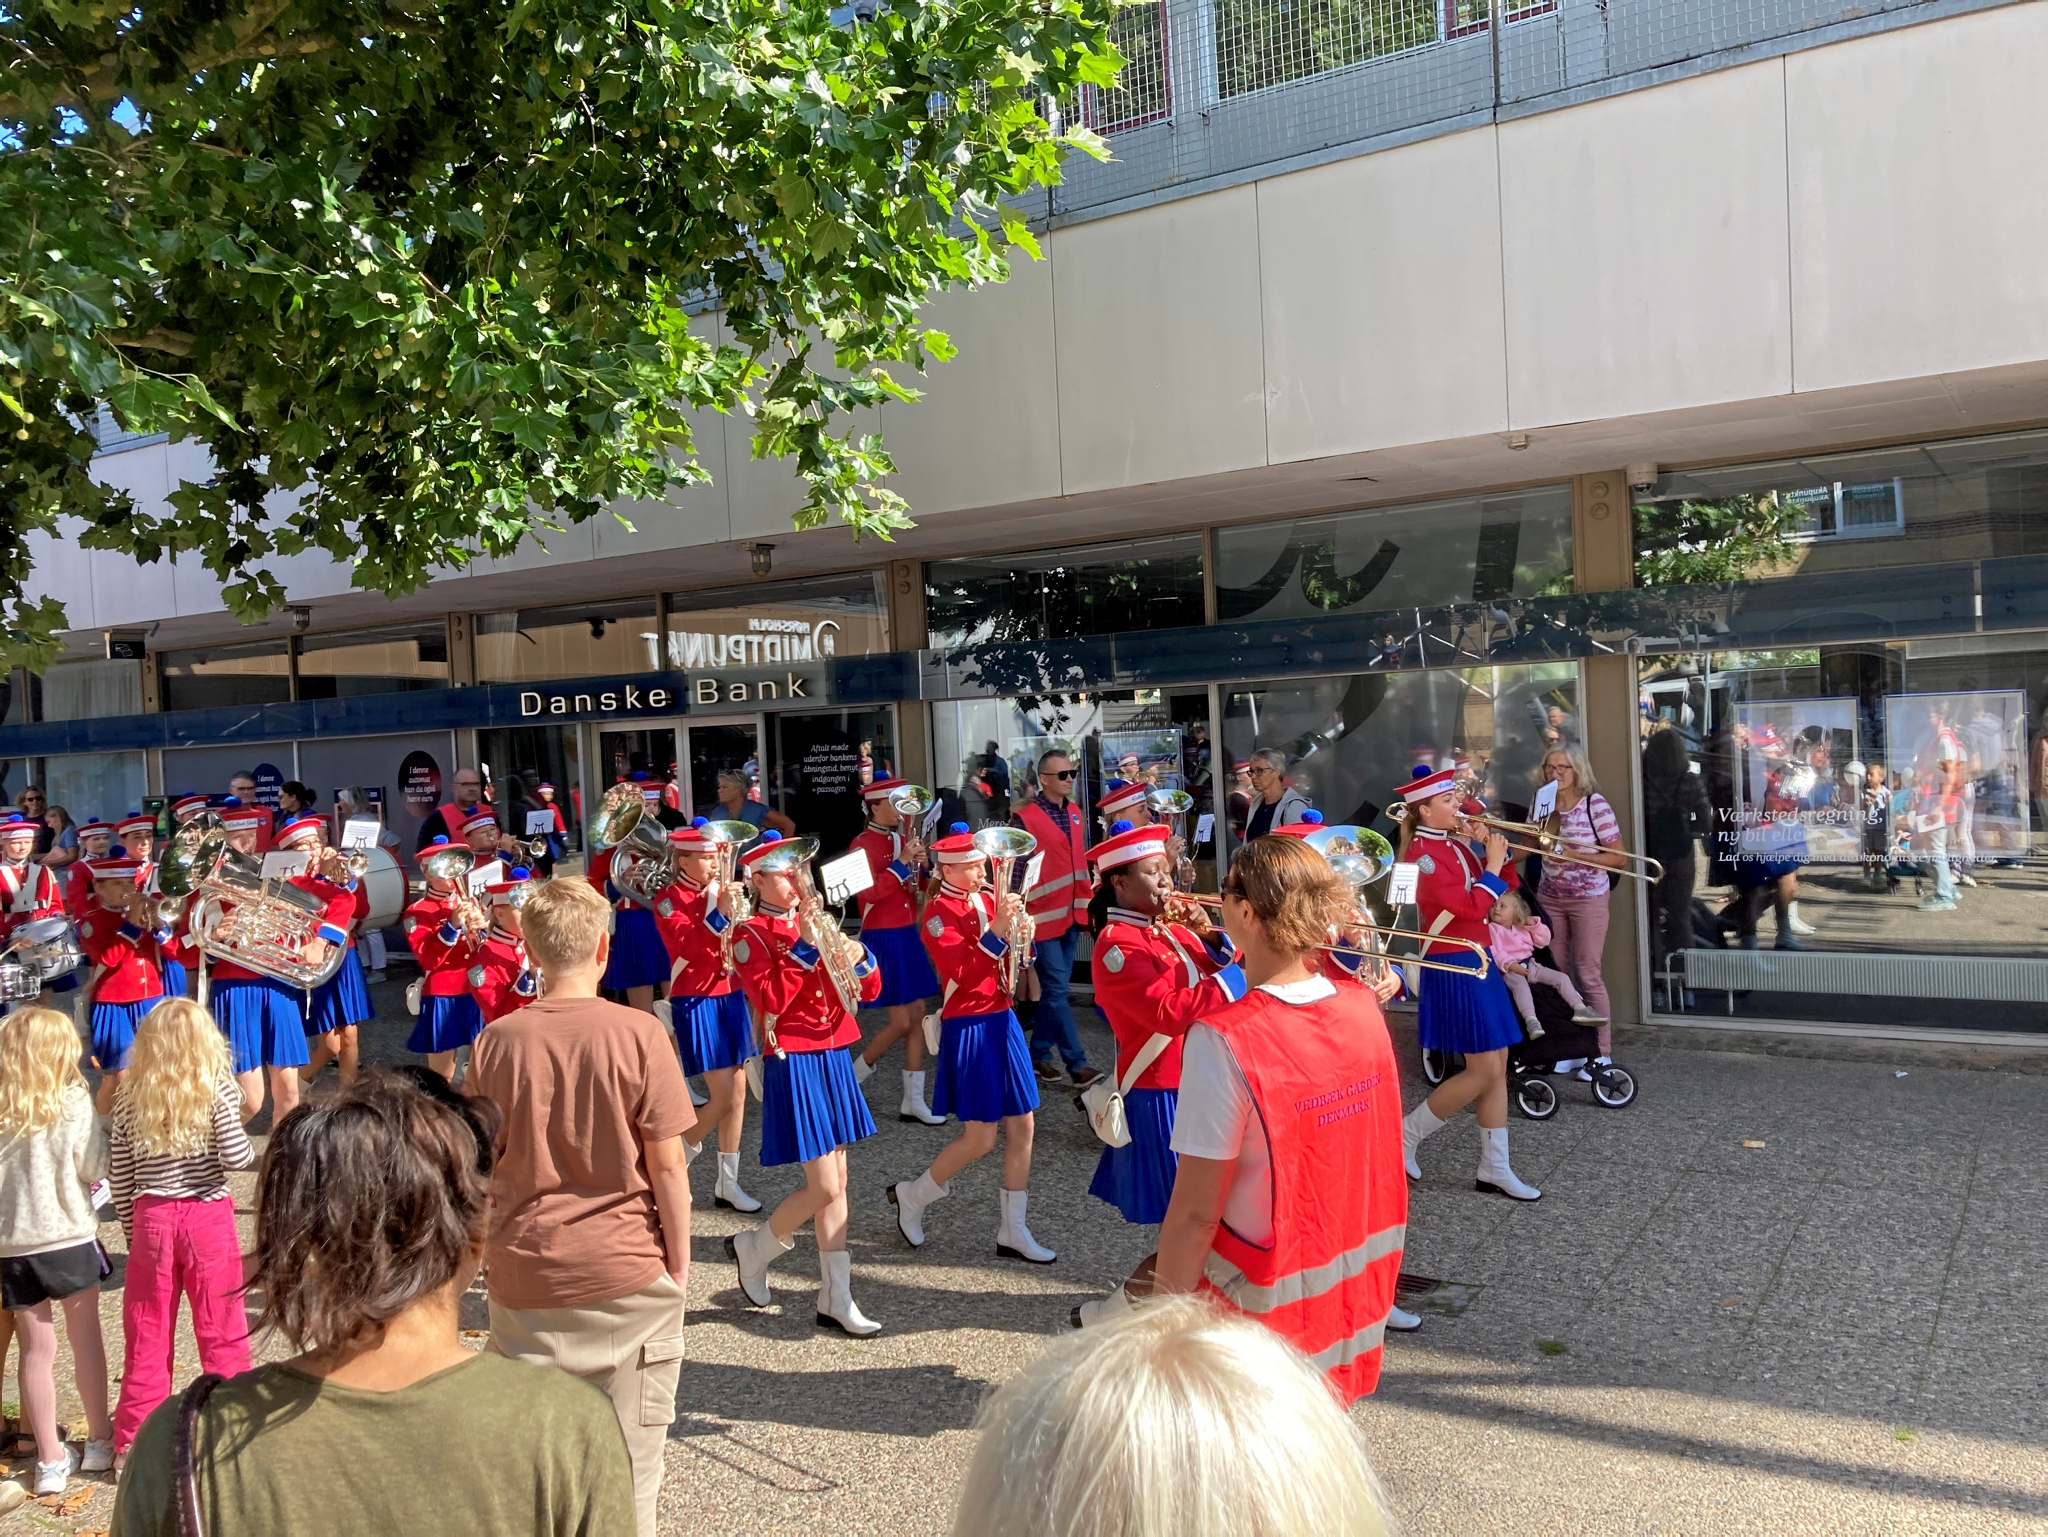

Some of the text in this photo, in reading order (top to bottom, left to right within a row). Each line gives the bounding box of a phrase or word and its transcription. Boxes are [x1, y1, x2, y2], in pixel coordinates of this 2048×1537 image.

[520, 672, 807, 717] Danske Bank
[811, 743, 849, 753] Aftalt møde
[803, 755, 829, 763] udenfor
[840, 764, 859, 773] benyt
[812, 774, 847, 784] indgangen
[1718, 807, 1883, 825] Værkstedsregning,
[1718, 831, 1740, 845] ny
[1745, 827, 1767, 842] bil
[1718, 852, 1740, 862] Lad
[1742, 854, 1754, 862] os
[1756, 852, 1788, 864] hjælpe
[1793, 852, 1810, 864] dig
[1294, 1073, 1381, 1113] VEDBÆK GARDEN
[1317, 1099, 1370, 1127] DENMARK
